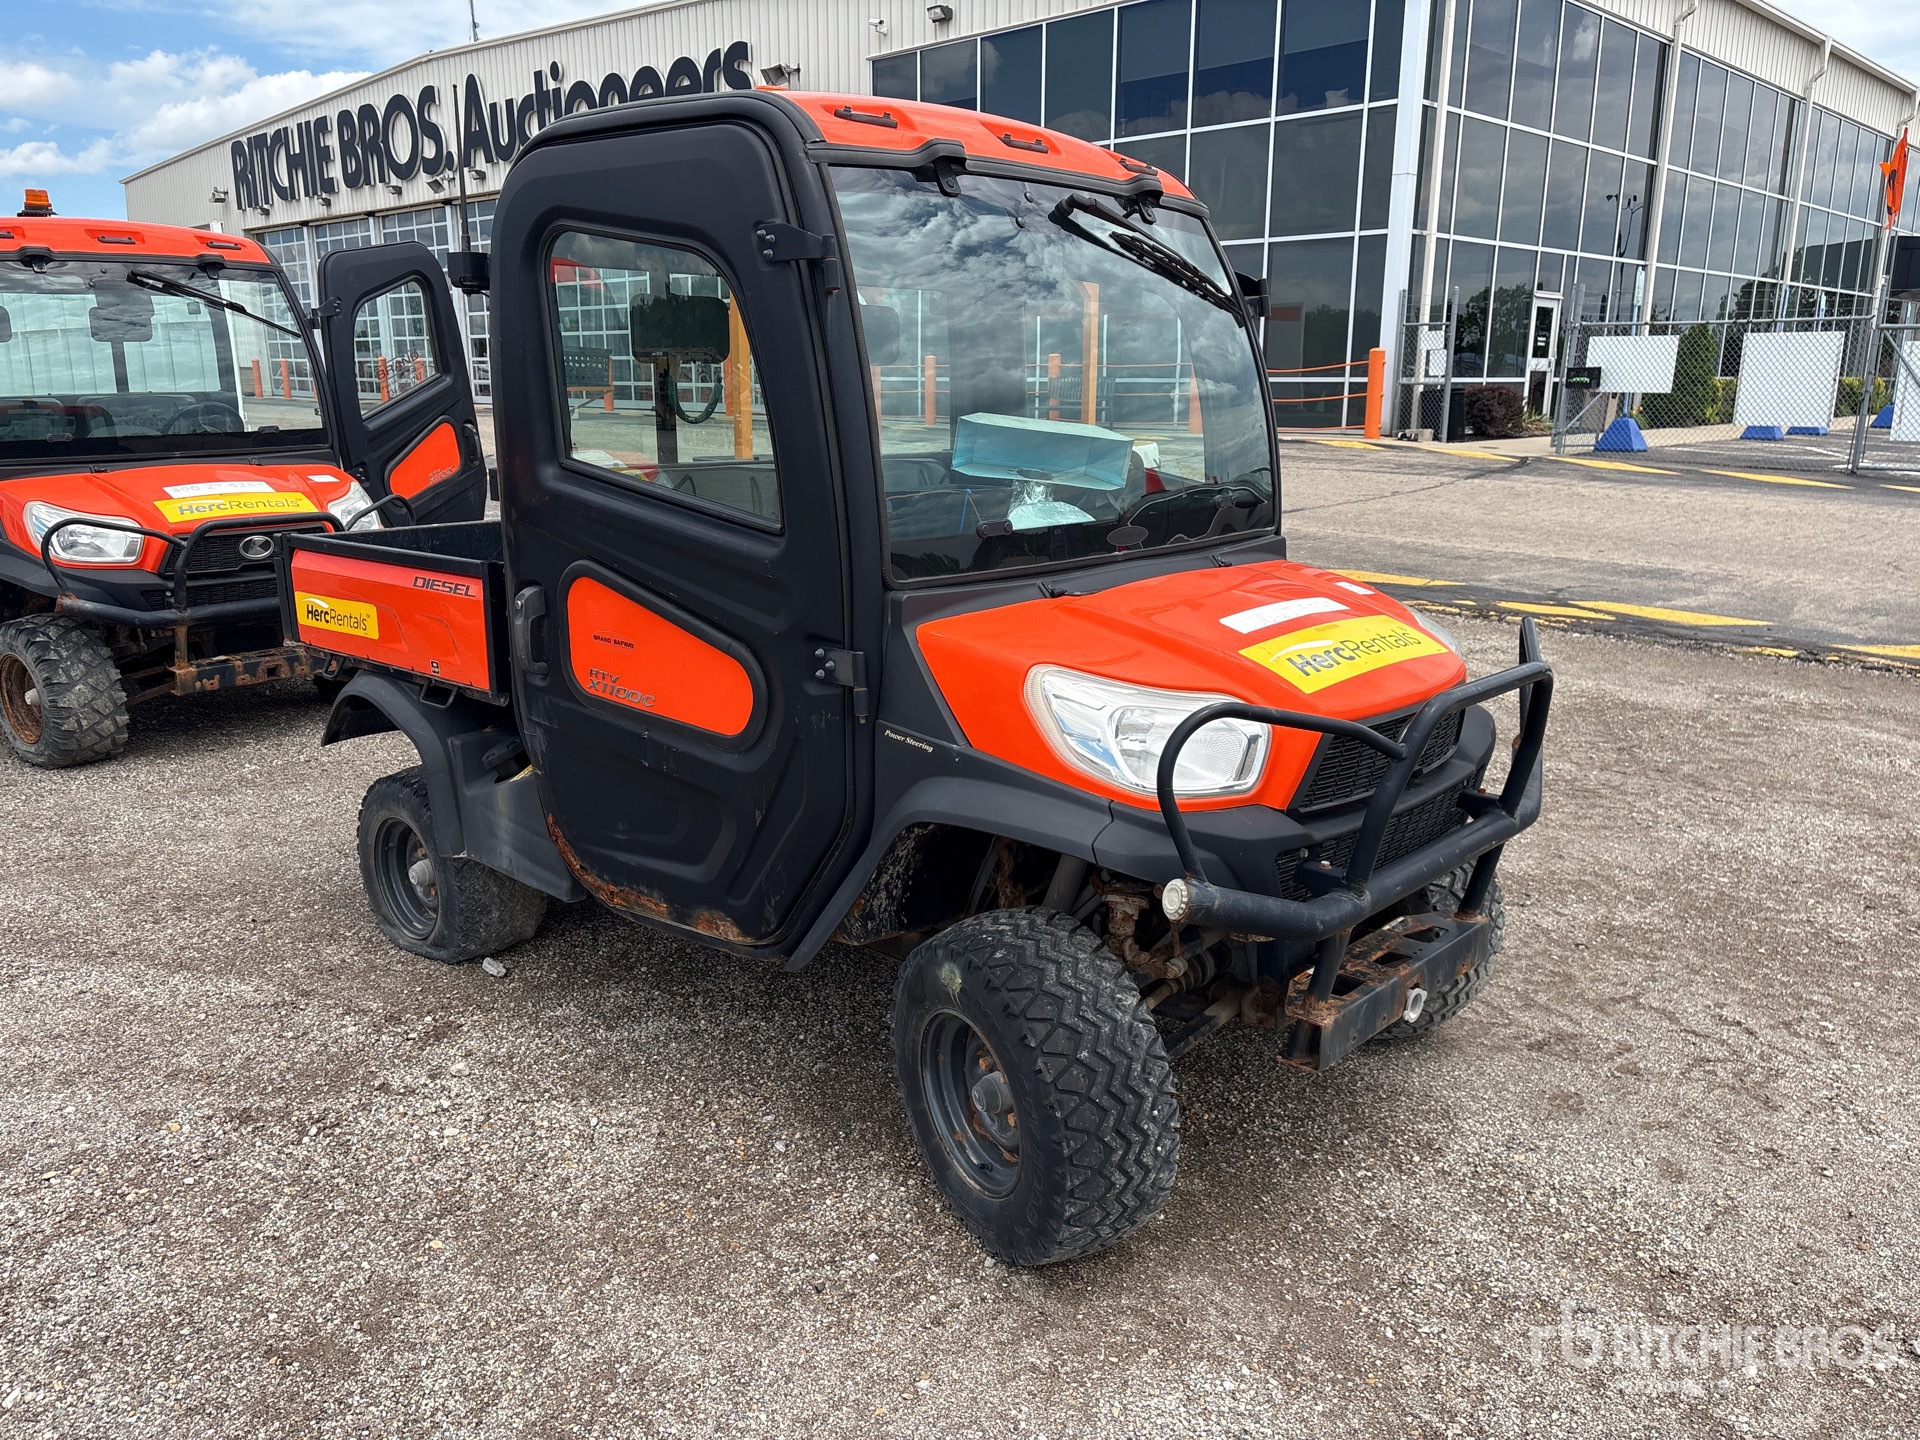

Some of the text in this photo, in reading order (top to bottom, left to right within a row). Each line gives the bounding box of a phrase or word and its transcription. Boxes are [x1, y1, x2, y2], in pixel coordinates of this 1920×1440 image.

[231, 115, 339, 210] RITCHIE
[412, 576, 476, 598] DIESEL
[593, 634, 612, 644] BRAND
[589, 667, 620, 684] RTV
[586, 678, 656, 707] X1100C
[884, 729, 934, 753] Power Steering
